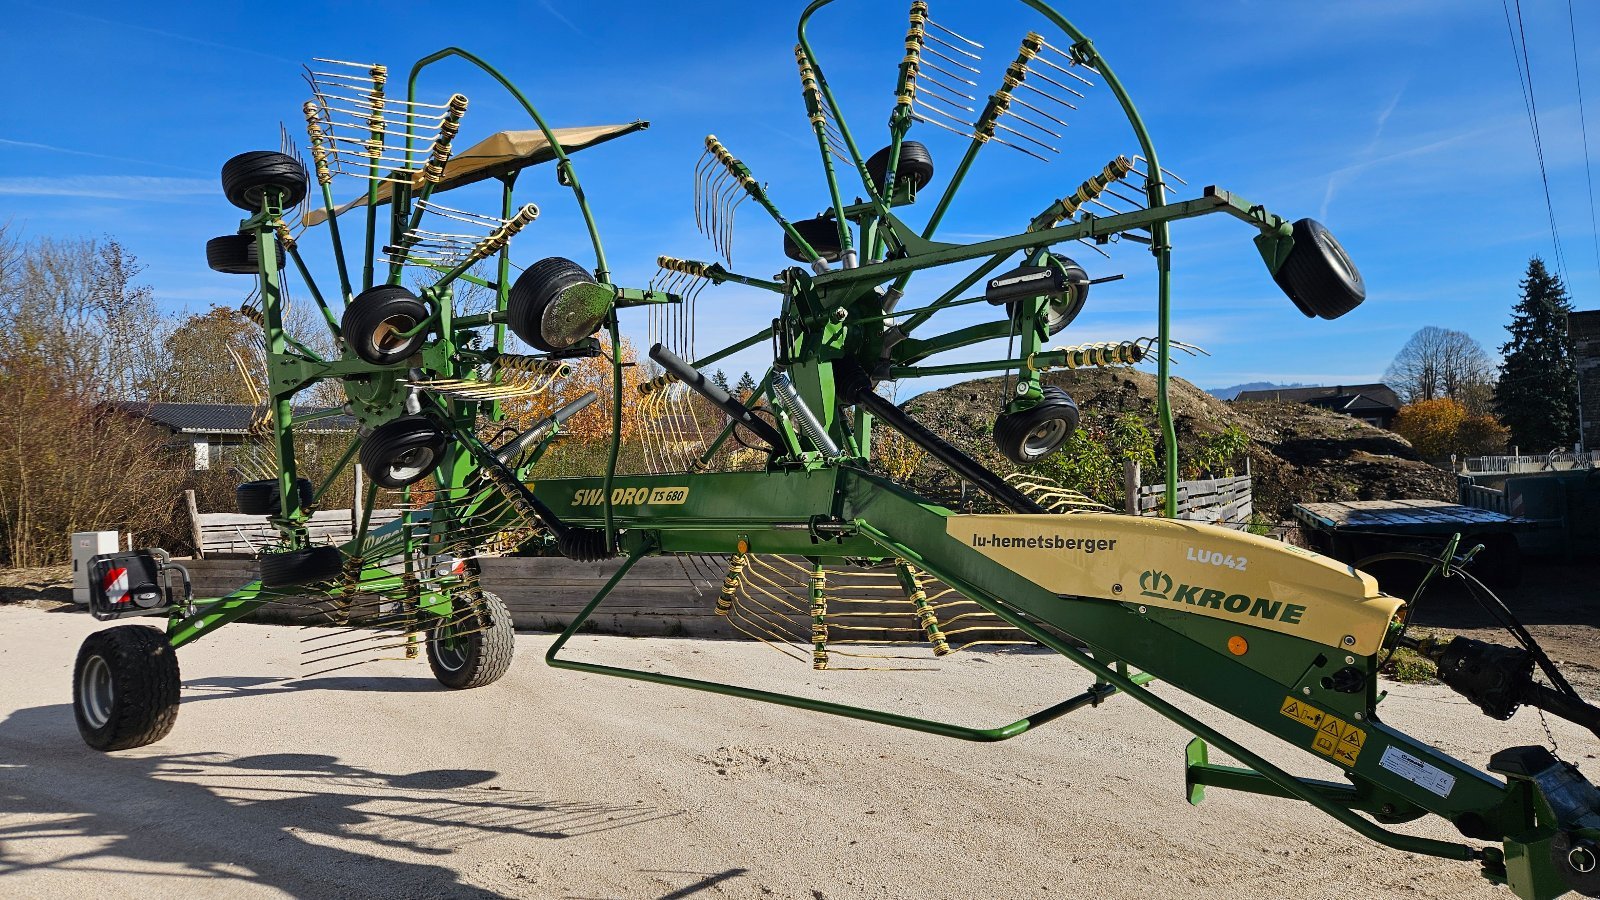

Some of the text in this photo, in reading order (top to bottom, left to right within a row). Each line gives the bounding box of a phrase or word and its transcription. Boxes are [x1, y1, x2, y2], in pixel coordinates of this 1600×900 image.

[653, 491, 665, 502] TS
[666, 490, 684, 501] 680
[972, 533, 1117, 554] lu-hemetsberger
[1186, 547, 1248, 571] LU042
[1172, 583, 1307, 625] KRONE
